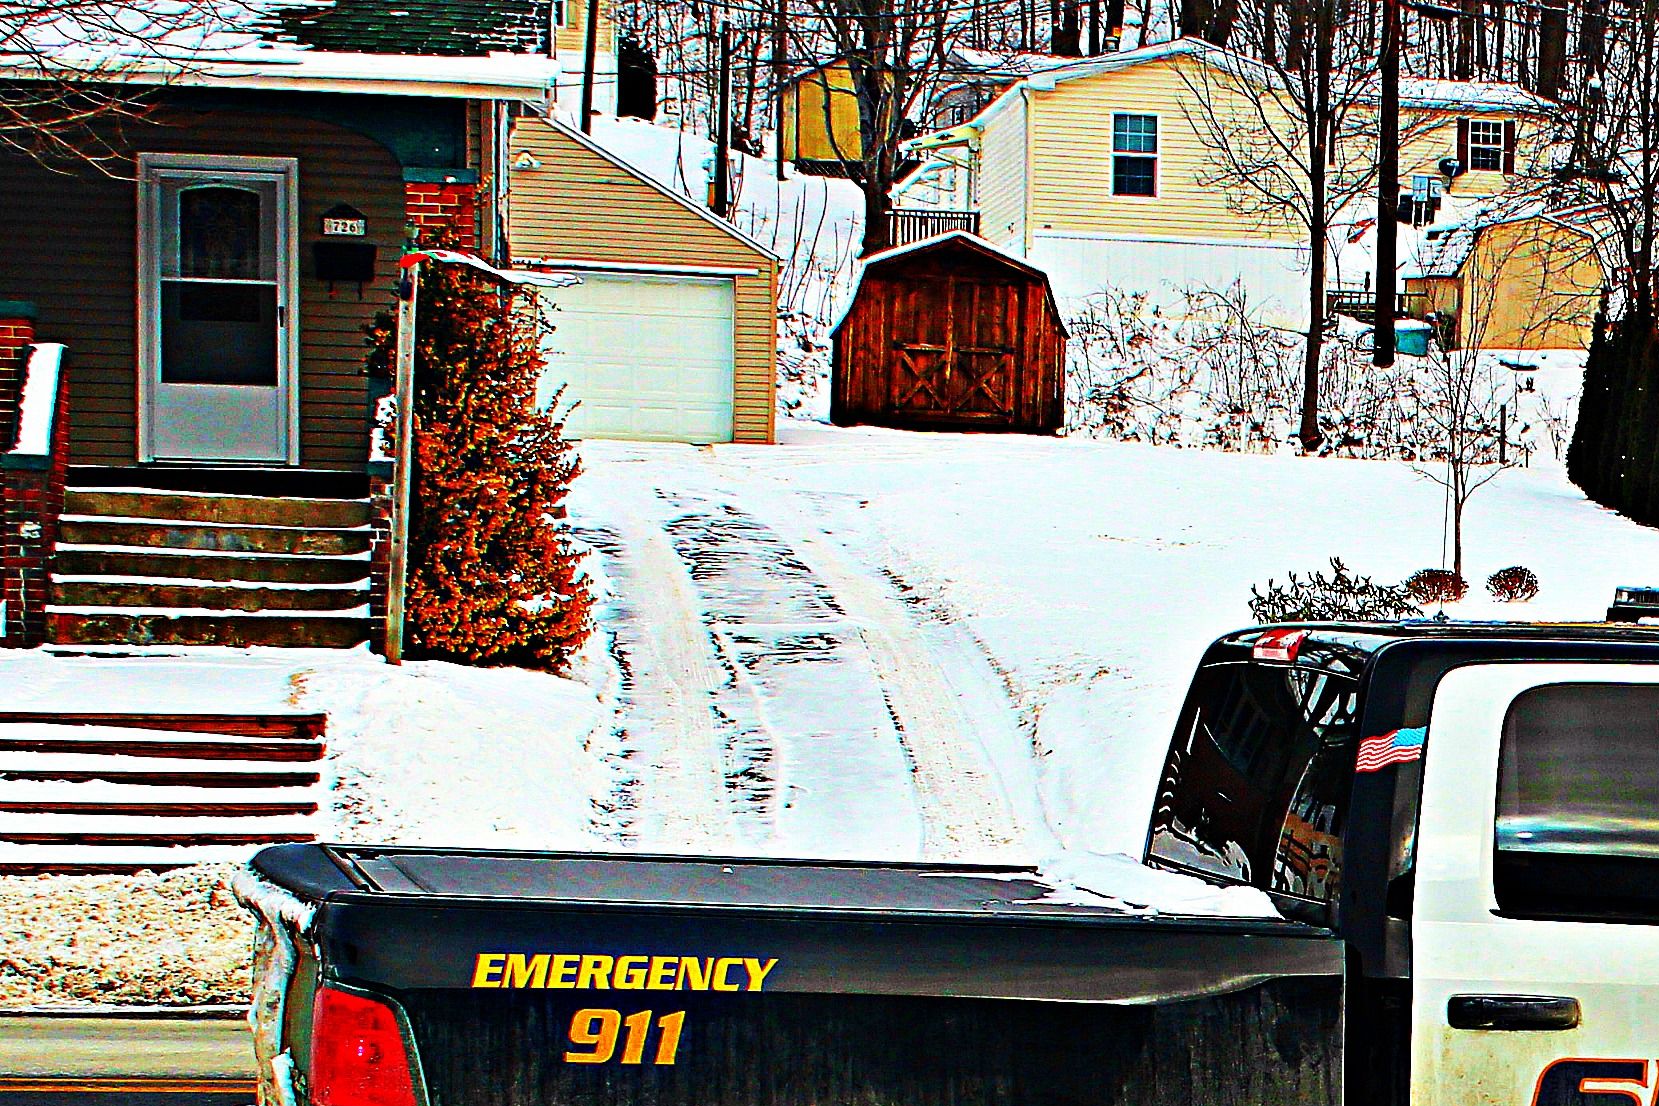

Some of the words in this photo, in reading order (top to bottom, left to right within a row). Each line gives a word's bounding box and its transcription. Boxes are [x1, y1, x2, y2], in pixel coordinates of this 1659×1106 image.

[334, 221, 356, 233] 726
[471, 953, 779, 992] EMERGENCY
[563, 1008, 686, 1065] 911
